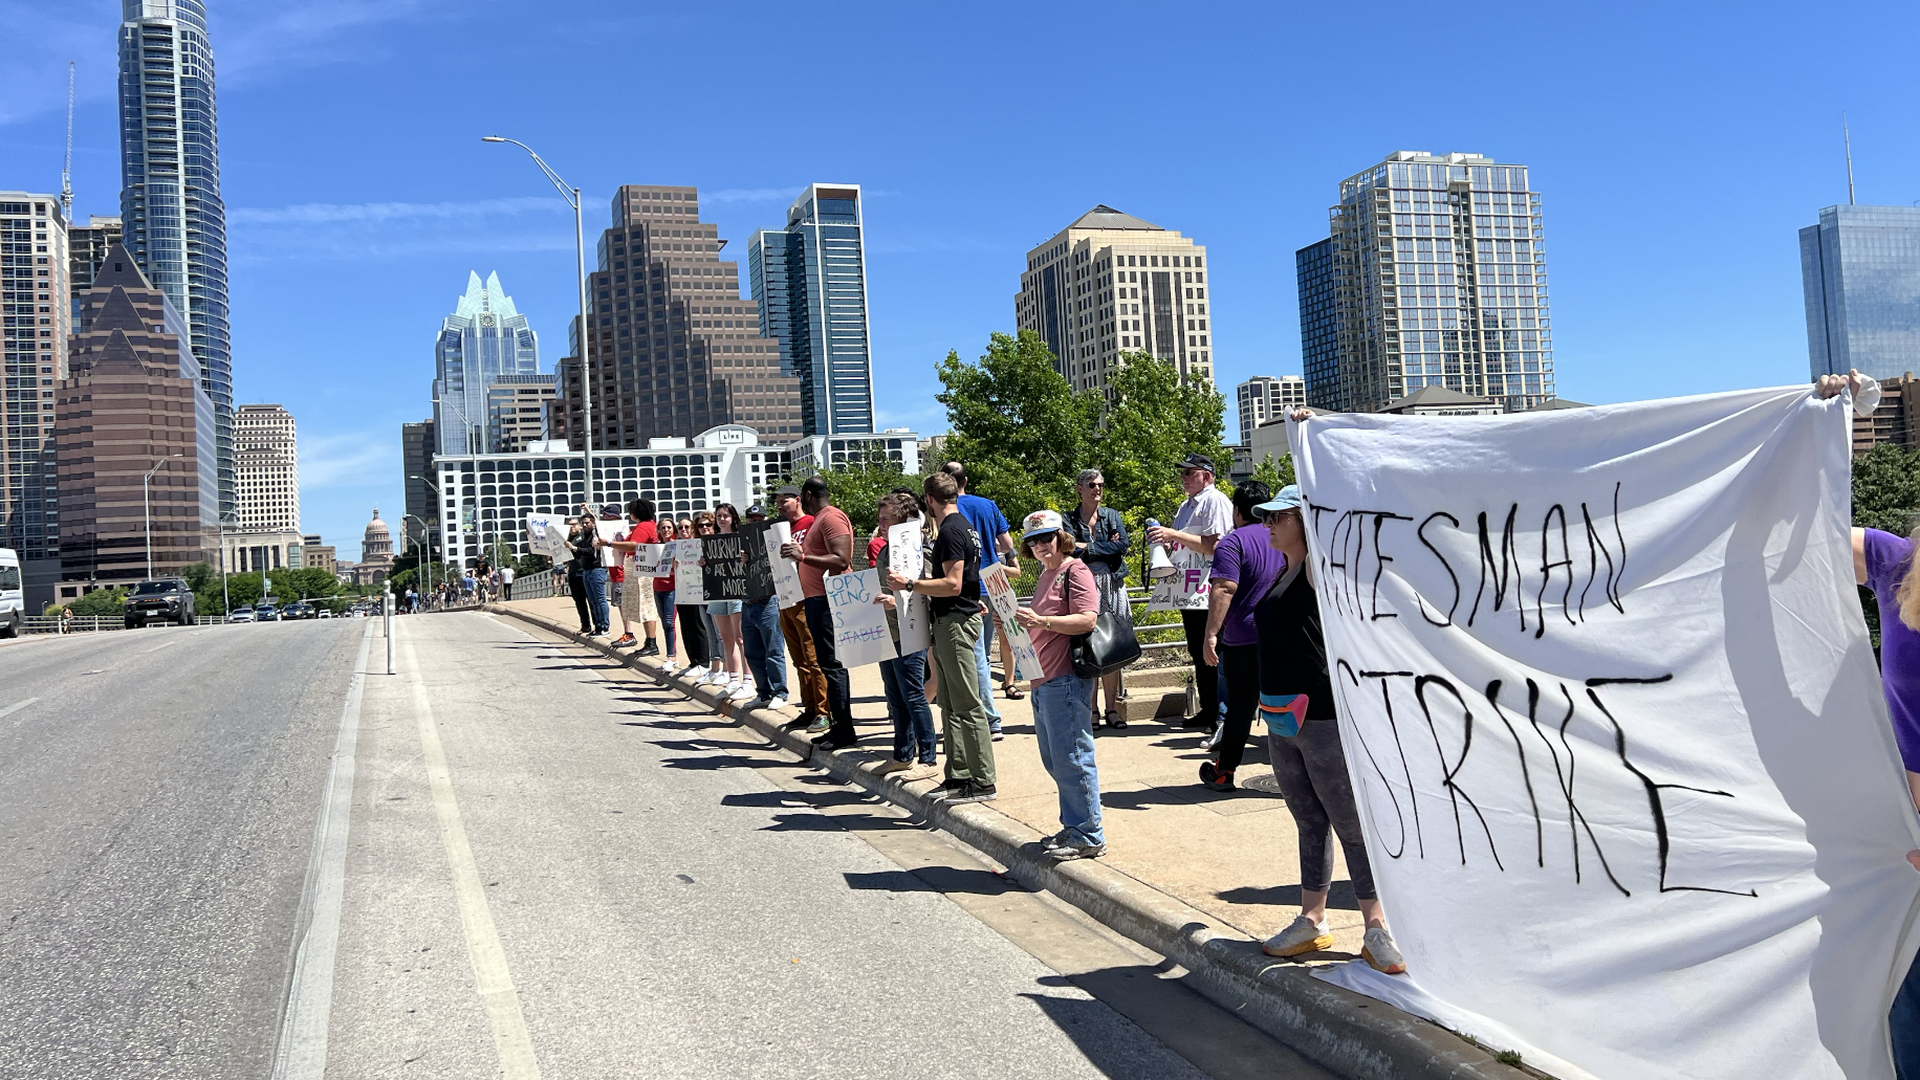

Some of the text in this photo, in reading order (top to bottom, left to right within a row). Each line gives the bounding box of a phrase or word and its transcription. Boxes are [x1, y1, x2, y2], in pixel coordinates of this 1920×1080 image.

[1303, 481, 1627, 638] TATESMAN
[722, 578, 747, 597] MORE
[825, 572, 865, 594] COPY
[984, 568, 1010, 597] HONK
[1337, 658, 1758, 898] STRIKE
